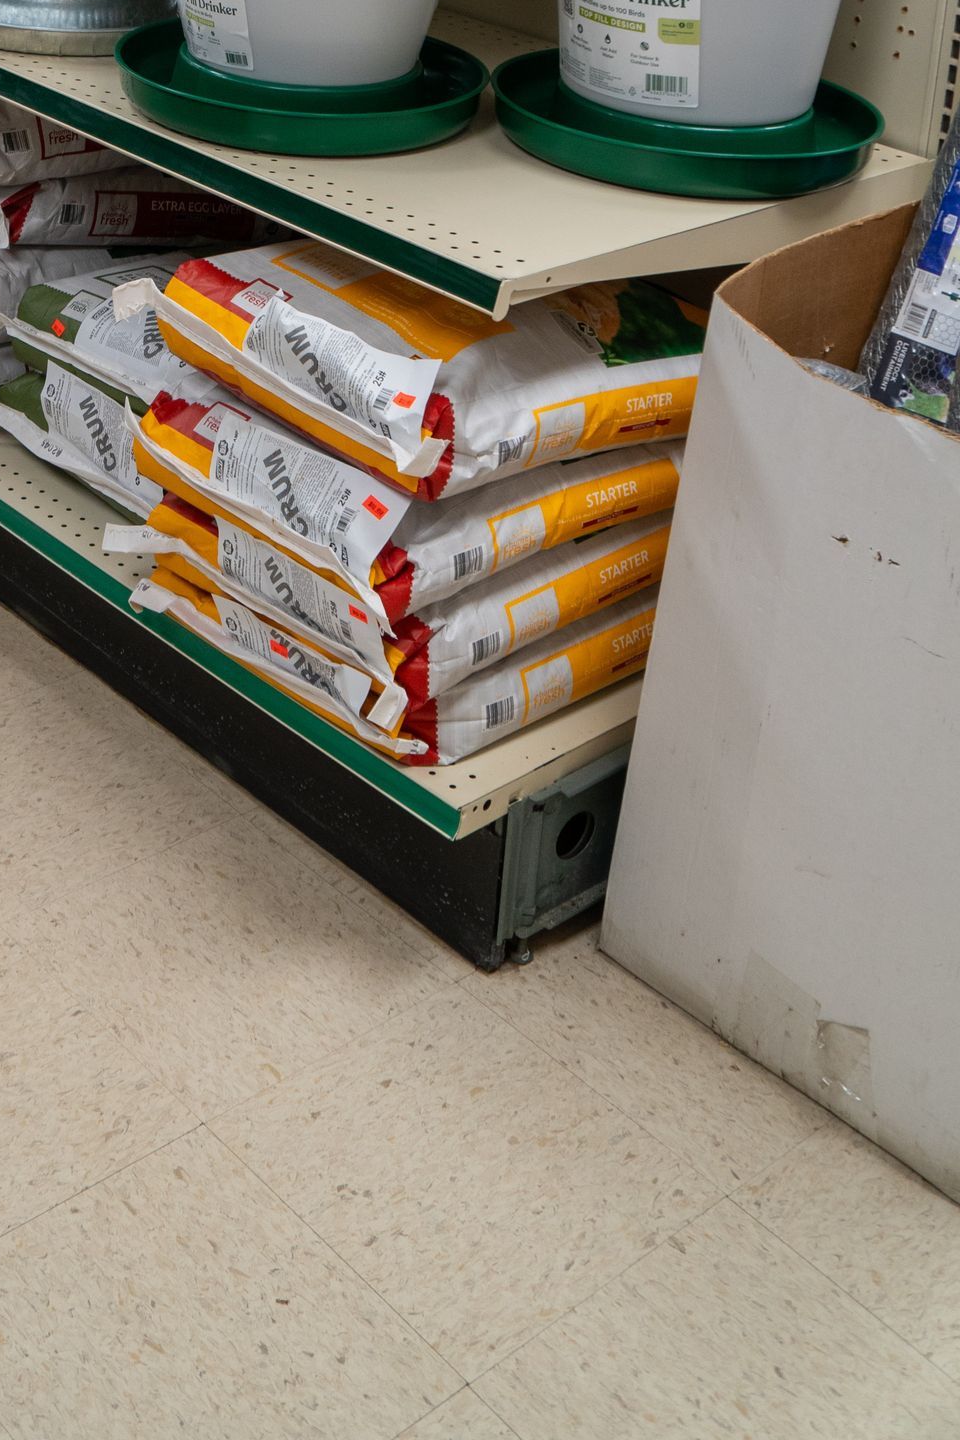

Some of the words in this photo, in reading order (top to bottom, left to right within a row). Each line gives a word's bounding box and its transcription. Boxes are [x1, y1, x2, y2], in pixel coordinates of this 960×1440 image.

[580, 7, 592, 19] TOP
[593, 13, 609, 25] FILL
[610, 17, 644, 32] DESIGN
[599, 3, 607, 11] up
[616, 6, 627, 15] 100
[628, 8, 646, 18] Birds
[48, 130, 80, 146] fresh
[150, 199, 186, 212] EXTRA
[188, 201, 210, 213] EGG
[100, 213, 129, 227] fresh
[69, 301, 87, 315] fresh
[241, 290, 267, 310] fresh
[284, 324, 347, 412] CRUM
[881, 340, 904, 392] CONTAINMENT
[890, 342, 911, 383] LIVESTOCK
[372, 370, 387, 387] 25#
[626, 392, 674, 413] STARTER
[78, 395, 117, 472] CRUM
[541, 435, 574, 450] fresh
[262, 448, 309, 538] CRUM
[339, 488, 352, 507] 25#
[585, 480, 638, 509] STARTER
[503, 538, 537, 560] fresh
[599, 550, 650, 585] STARTER
[263, 555, 323, 634] CRUM
